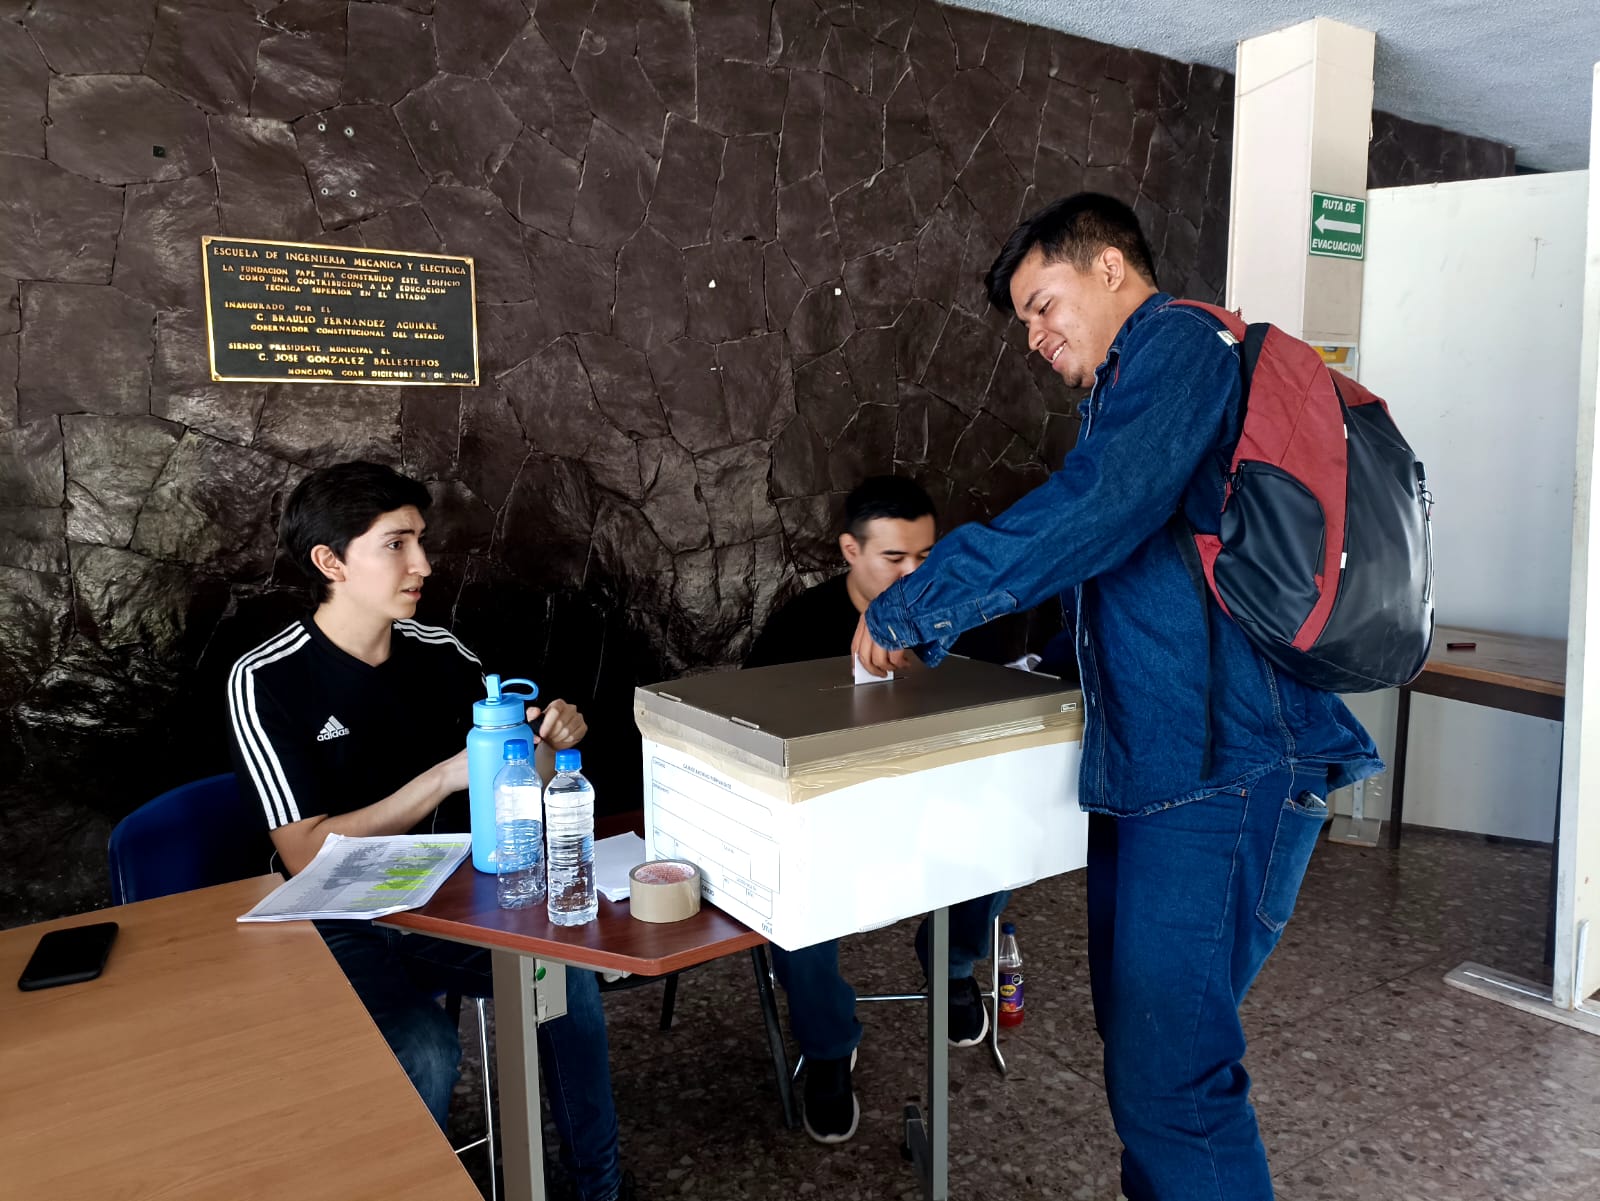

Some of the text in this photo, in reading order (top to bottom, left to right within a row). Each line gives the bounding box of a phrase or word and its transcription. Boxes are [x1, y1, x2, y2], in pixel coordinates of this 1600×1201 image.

[1322, 199, 1356, 213] RUTA DE
[1312, 238, 1362, 253] EVACUACION
[213, 247, 258, 258] ESCUELA
[266, 251, 278, 259] DE
[286, 252, 346, 265] INGENIERIA
[354, 258, 402, 269] MECANICA
[420, 264, 466, 275] ELECTRICA
[240, 265, 288, 275] FUNDACION
[296, 269, 316, 277] PAPE
[341, 272, 394, 283] CONSTRUIDO
[239, 274, 265, 282] COMO
[297, 278, 363, 289] CONTRIBUCION
[400, 285, 446, 294] EDUCACION
[265, 284, 301, 292] TECNICA
[312, 287, 352, 296] SUPERIOR
[224, 301, 285, 310] INAUGURADO
[272, 314, 316, 324] BRAULIO
[324, 317, 386, 328] FERNANDEZ
[396, 322, 438, 330] AGUIRRE
[250, 324, 309, 333] GOBERNADOR
[316, 328, 386, 338] CONSTITUCIONAL
[270, 344, 321, 352] PRESIDENTE
[330, 346, 374, 354] MUNICIPAL
[258, 353, 440, 367] C. JOSE GONZALEZ BALLESTEROS
[316, 728, 350, 742] adidas
